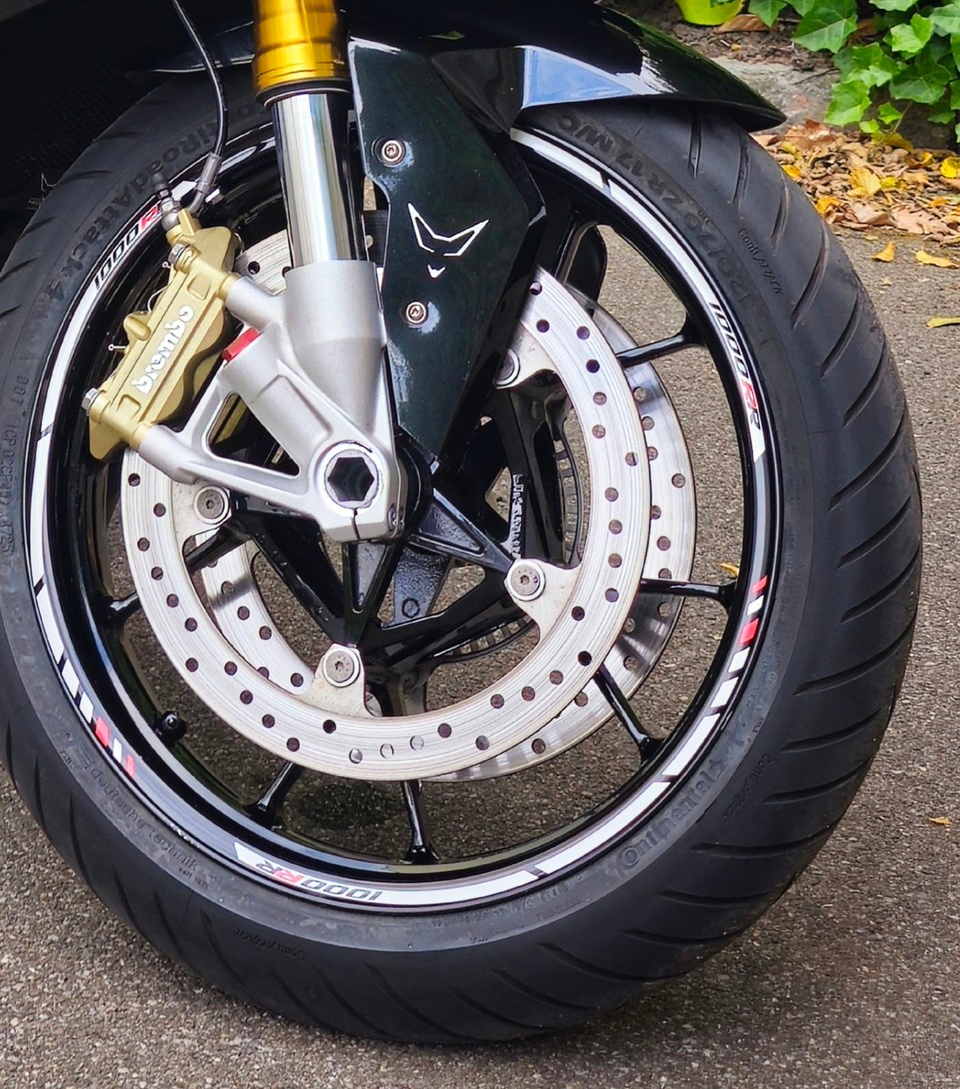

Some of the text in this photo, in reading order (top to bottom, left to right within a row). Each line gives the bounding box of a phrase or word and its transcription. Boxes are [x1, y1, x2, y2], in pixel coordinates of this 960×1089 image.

[94, 204, 163, 291] 1000R
[130, 305, 194, 395] brembo
[708, 302, 761, 431] 1000RR
[253, 856, 383, 902] 1000RR
